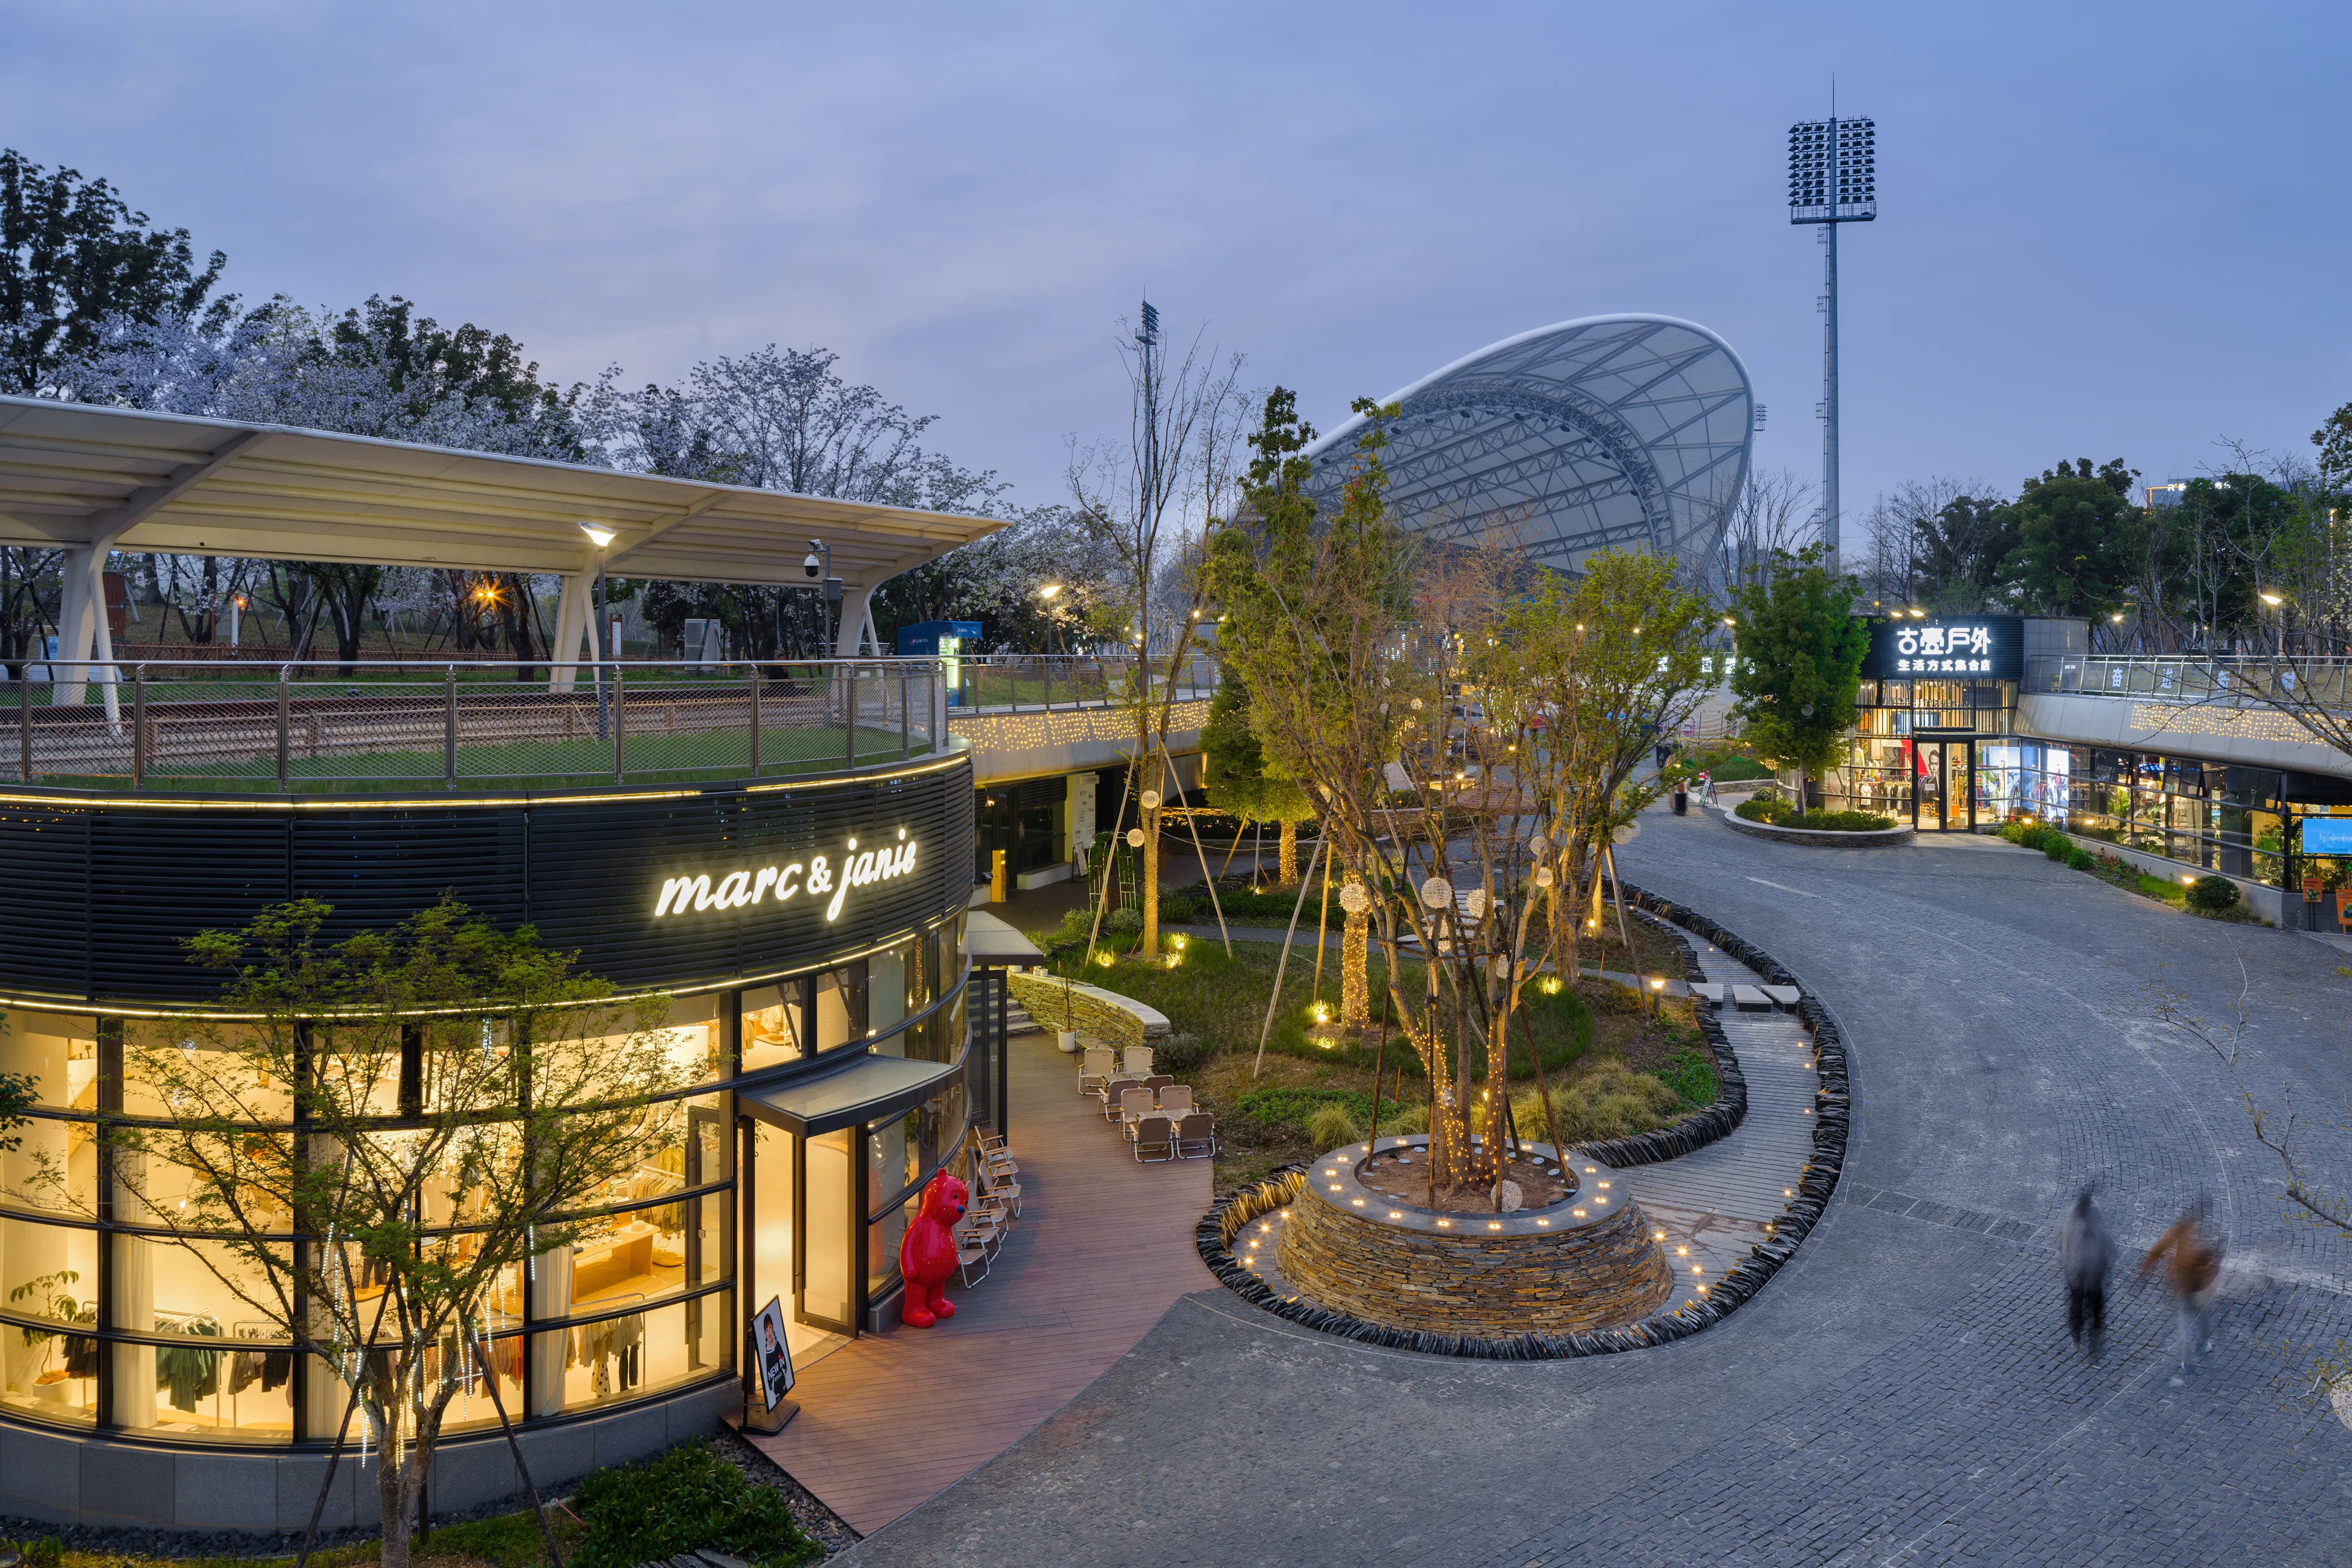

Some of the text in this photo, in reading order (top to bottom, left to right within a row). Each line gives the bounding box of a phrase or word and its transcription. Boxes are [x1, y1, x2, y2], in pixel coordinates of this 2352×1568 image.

[1898, 659, 1991, 671] 生活方式集合店
[655, 863, 802, 916] marc
[827, 828, 916, 921] janie
[767, 1356, 785, 1381] NEW IN
